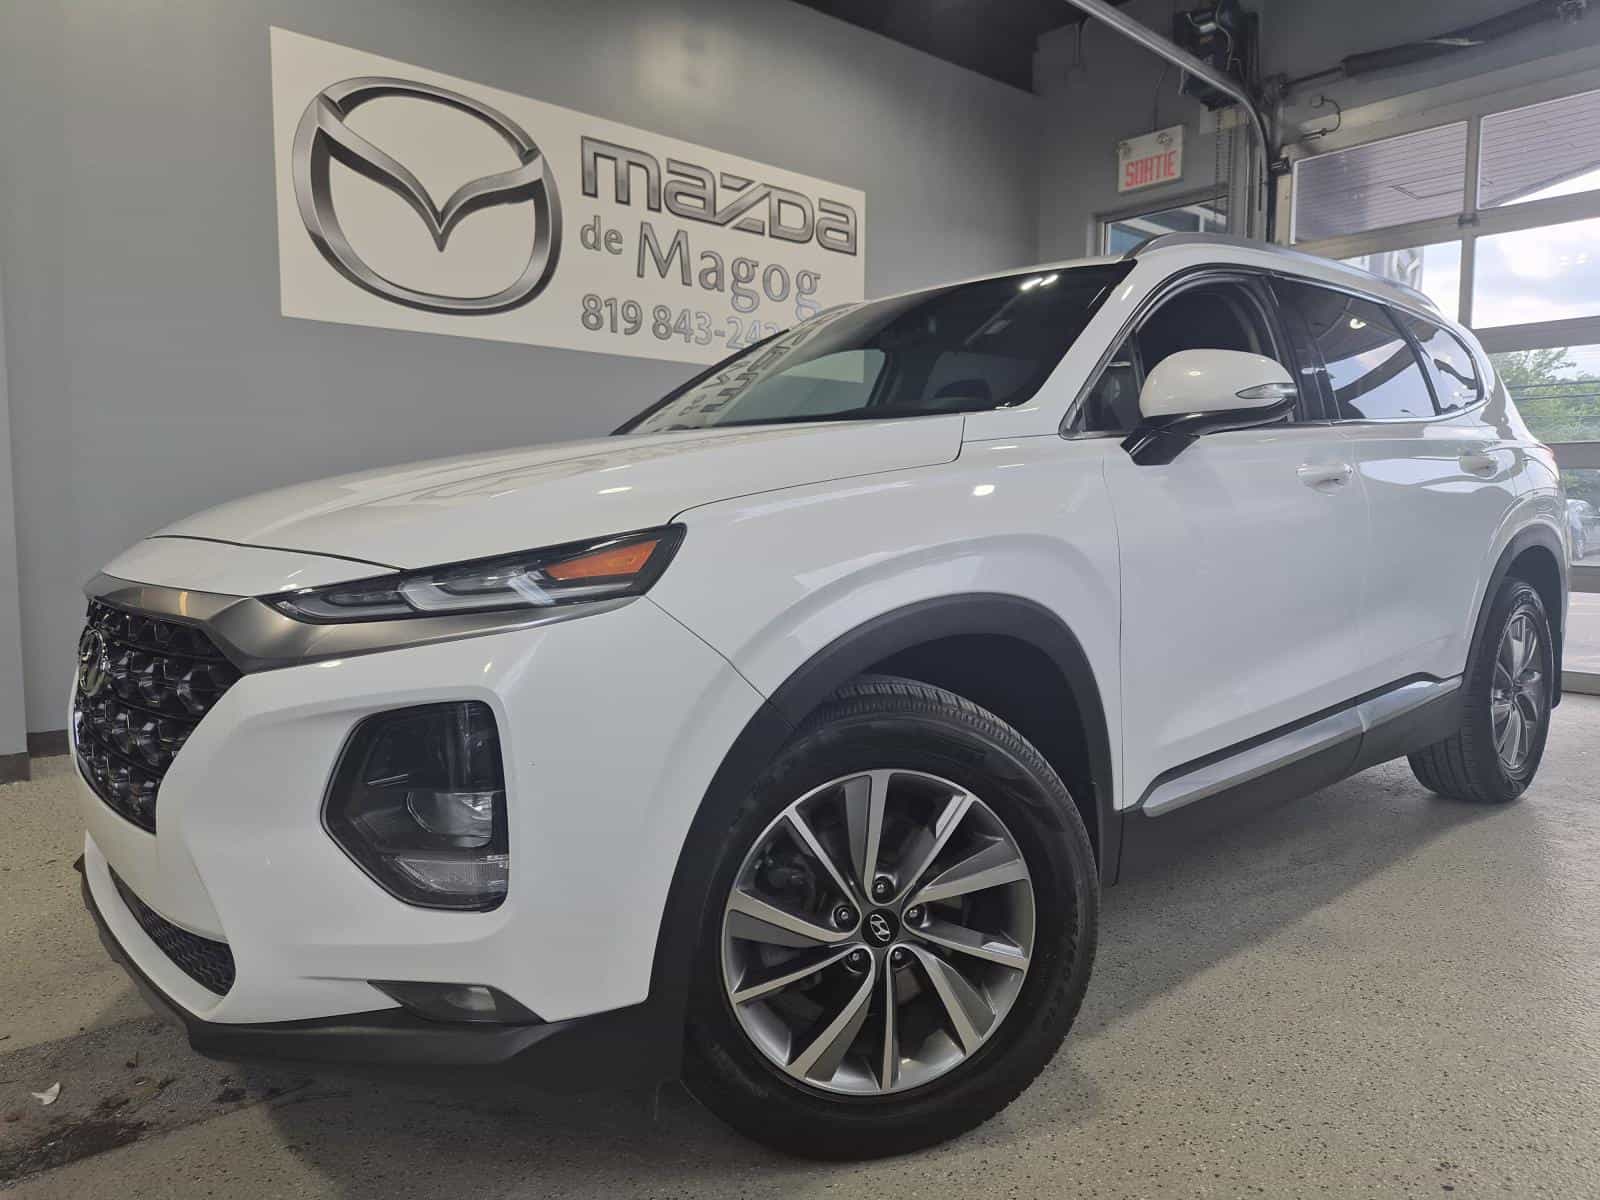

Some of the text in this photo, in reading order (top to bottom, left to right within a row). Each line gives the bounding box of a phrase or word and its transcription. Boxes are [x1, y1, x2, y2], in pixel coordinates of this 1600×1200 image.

[1124, 150, 1177, 188] SORTIE
[580, 214, 822, 320] de Magog
[581, 293, 643, 336] 819
